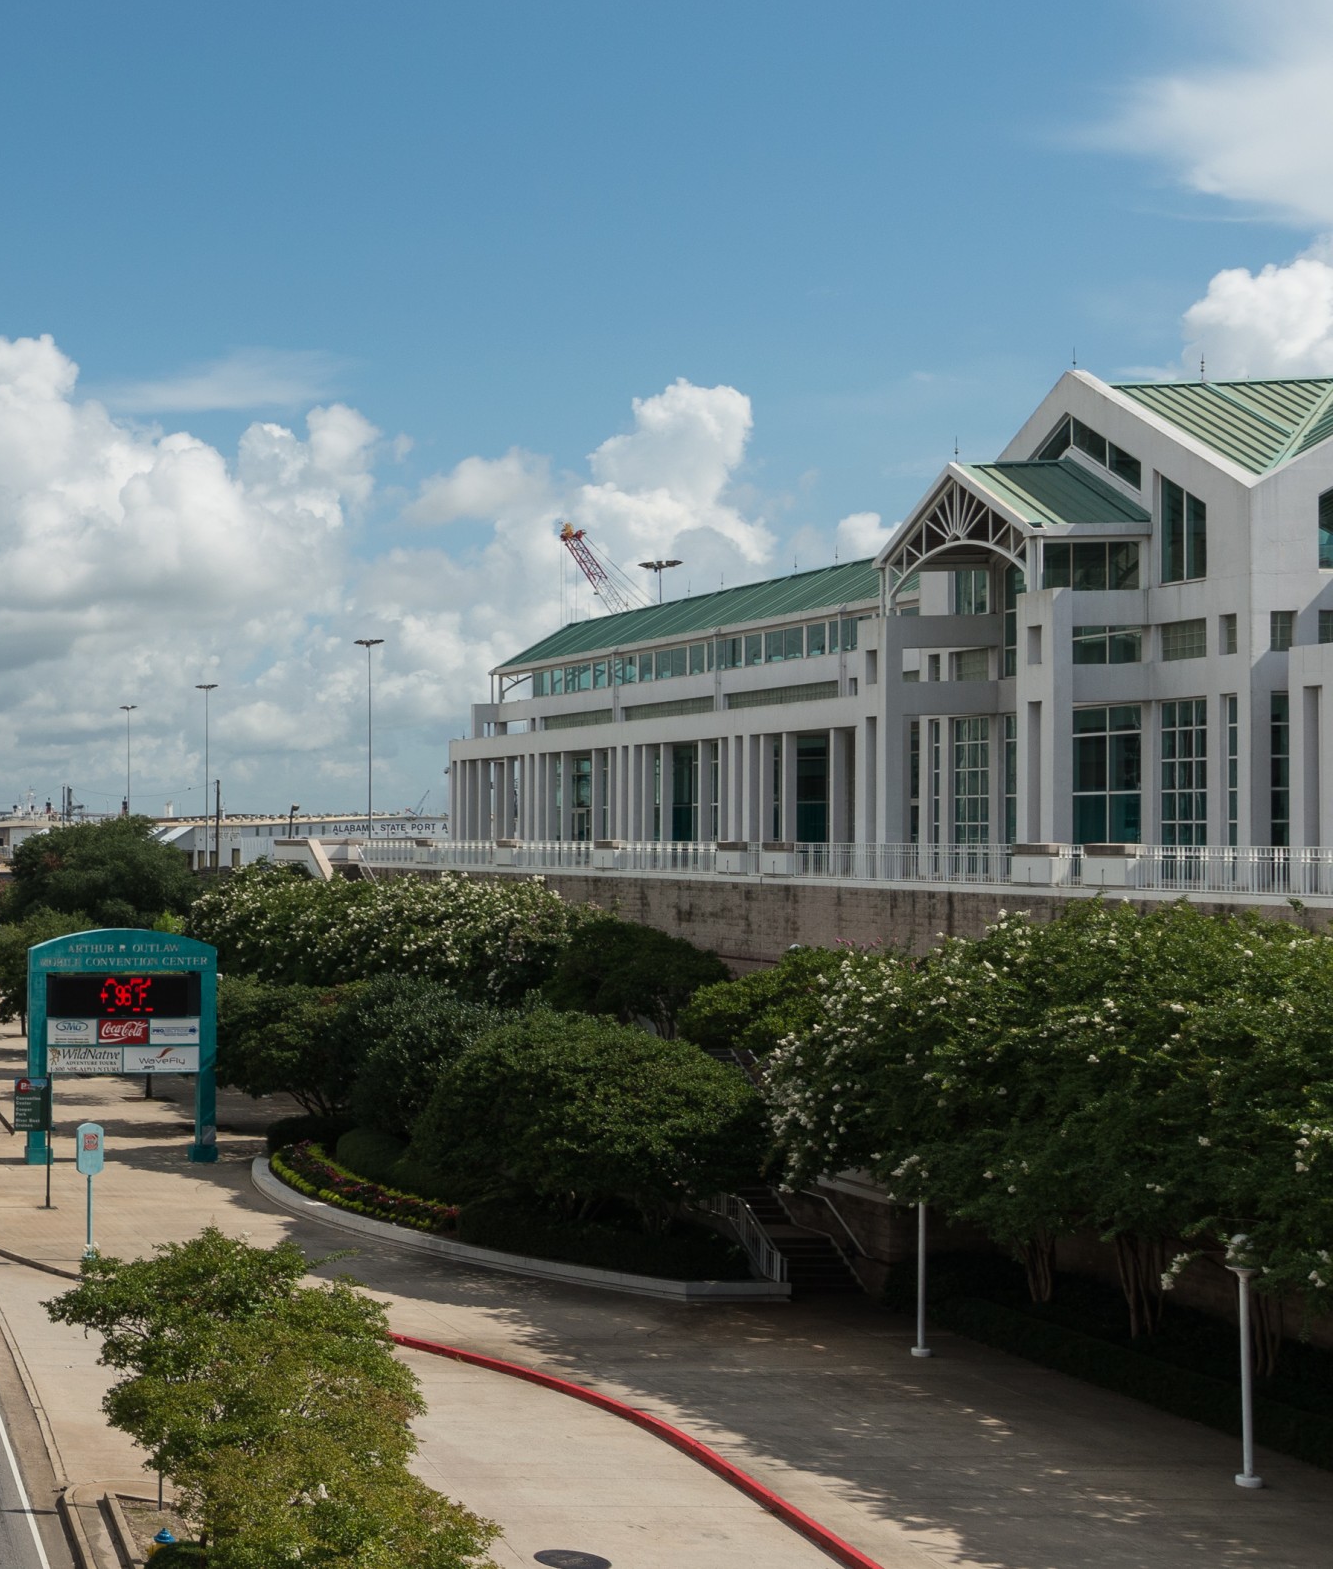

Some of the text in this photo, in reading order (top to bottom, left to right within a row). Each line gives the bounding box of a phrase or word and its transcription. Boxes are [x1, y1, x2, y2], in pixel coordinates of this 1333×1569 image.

[380, 823, 407, 832] STATE
[411, 823, 436, 831] PORT
[68, 944, 115, 953] ARTHUR
[132, 944, 180, 953] OUTLAW
[85, 957, 158, 967] CONVENTION
[161, 956, 208, 966] CENTER
